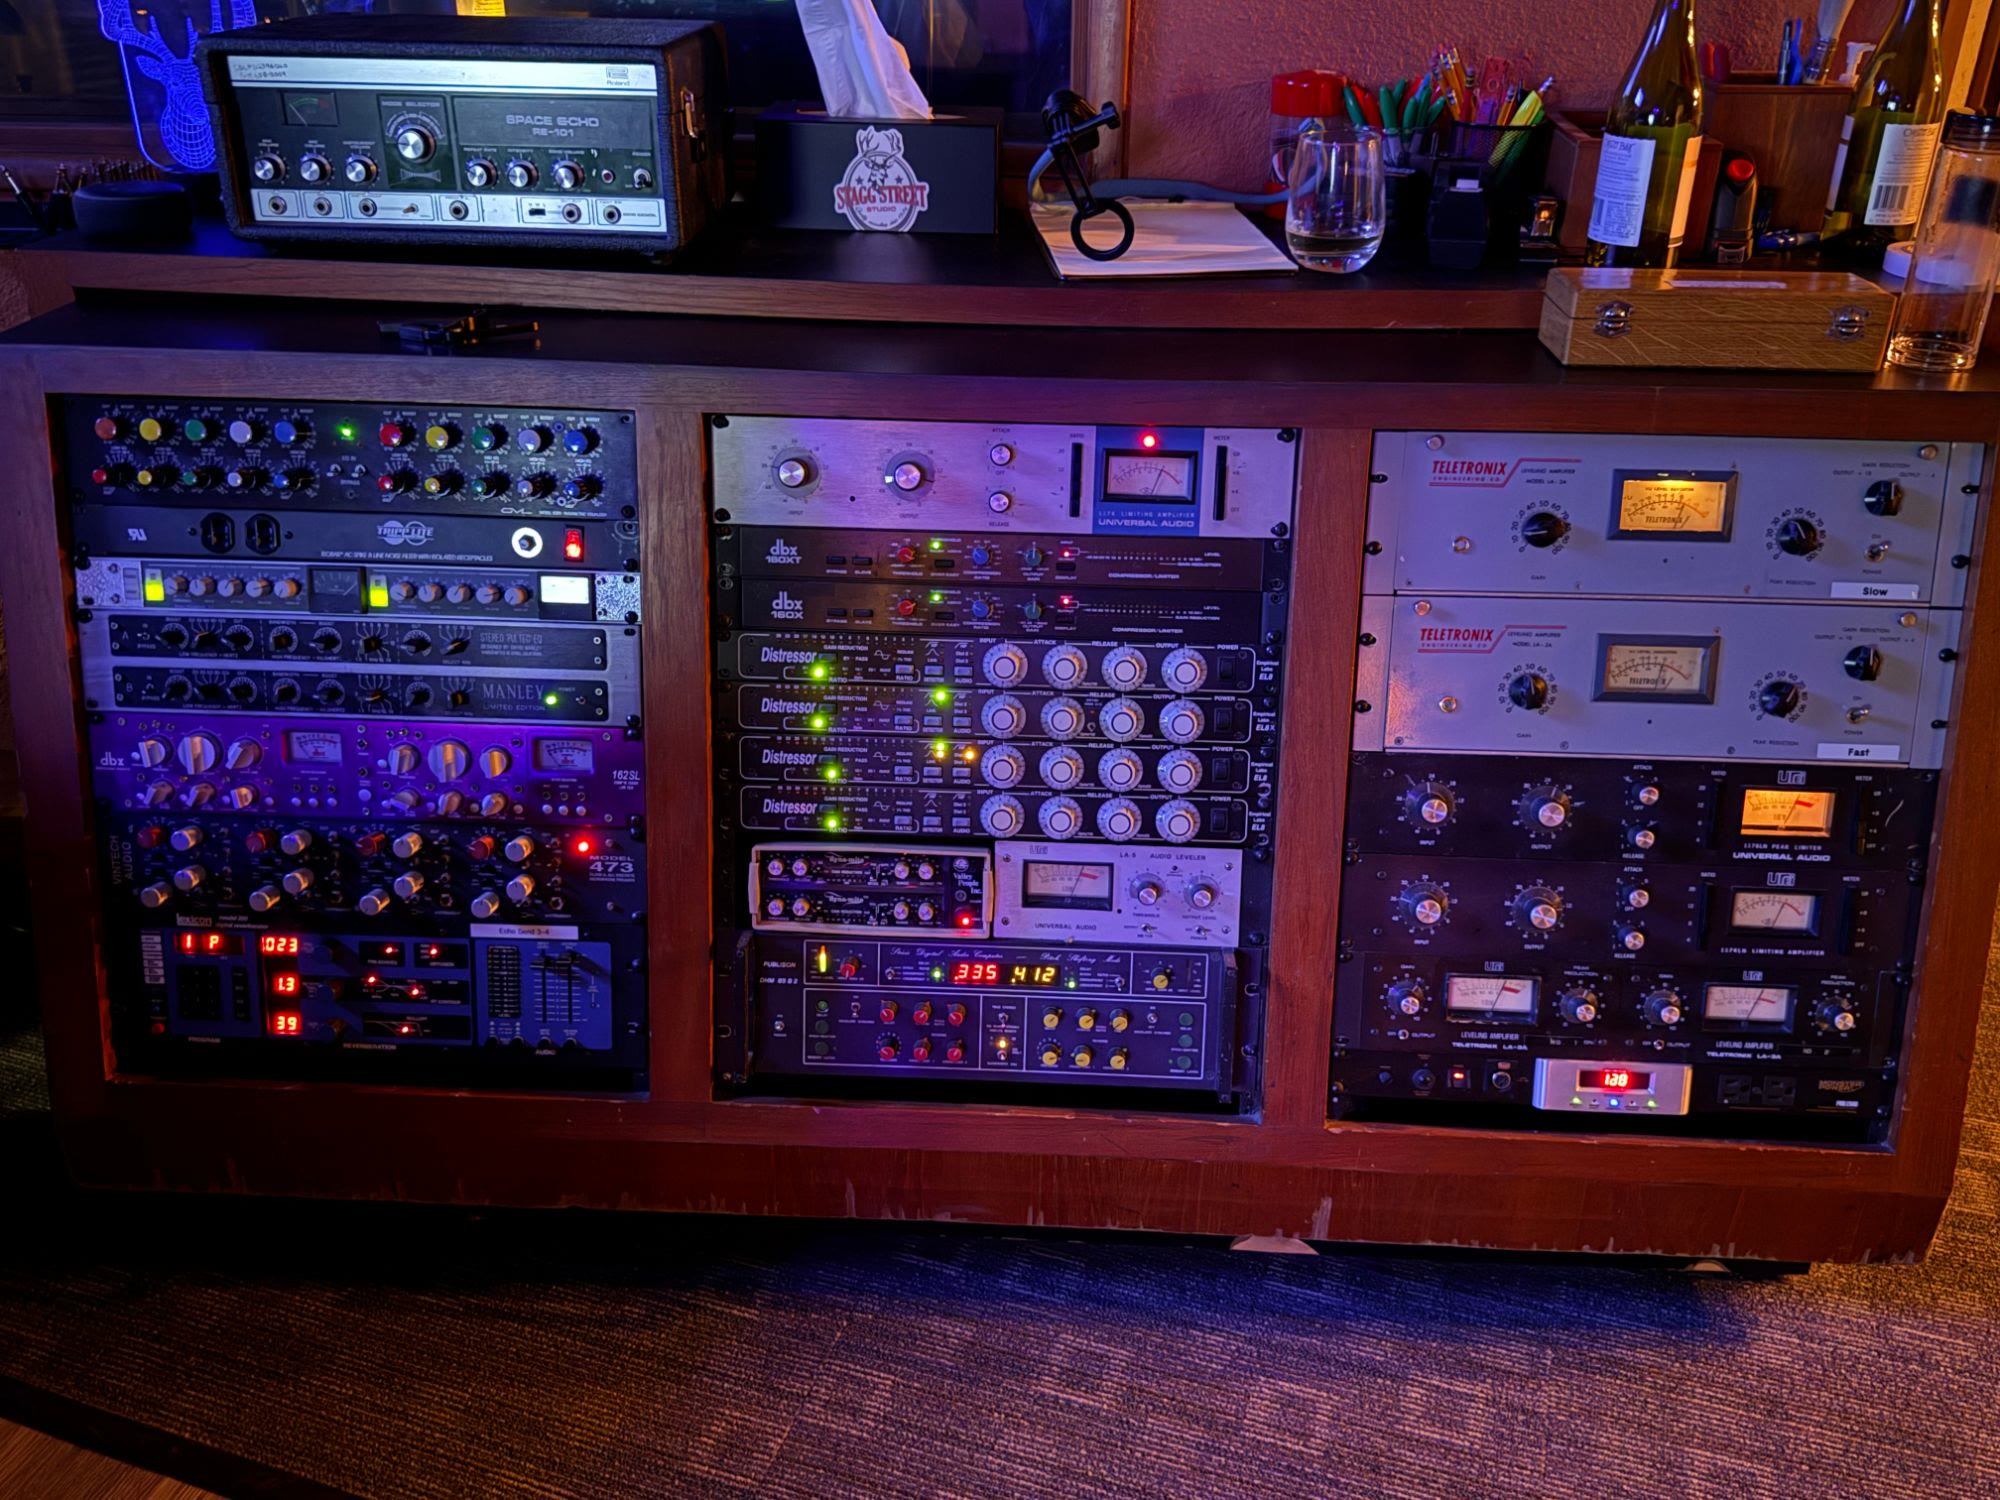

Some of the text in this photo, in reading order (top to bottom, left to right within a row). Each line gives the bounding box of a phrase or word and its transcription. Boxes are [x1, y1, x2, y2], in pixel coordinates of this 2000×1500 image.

[506, 114, 600, 127] SPACE ECHO
[532, 128, 574, 137] RE-101
[836, 185, 927, 210] STAGG STREET
[1431, 460, 1508, 476] TELETRONIX
[1098, 518, 1195, 528] UNIVERSAL AUDIO
[376, 525, 434, 538] TRIPP LITE
[770, 538, 798, 556] dbx
[765, 555, 802, 564] 160XT
[1862, 586, 1888, 597] Slow
[771, 591, 804, 611] dbx
[770, 610, 804, 620] 160X
[480, 632, 505, 643] STEREO
[1420, 627, 1495, 642] TELETRONIX
[761, 646, 817, 664] Distressor
[1258, 672, 1274, 681] EL8
[482, 683, 544, 700] MANLEY
[1152, 693, 1177, 701] OUTPUT
[482, 702, 546, 712] LIMITED EDITION
[761, 697, 816, 714] Distressor
[761, 748, 817, 766] Distressor
[1847, 748, 1870, 757] Fast
[100, 751, 125, 767] dbx
[612, 770, 641, 781] 162SL
[1253, 774, 1268, 782] EL8
[763, 798, 817, 815] Distressor
[1251, 823, 1266, 832] EL8
[110, 835, 122, 886] VINTECH
[121, 841, 134, 881] AUDIO
[1732, 852, 1831, 862] UNIVERSAL AUDIO
[589, 861, 634, 873] 473
[953, 872, 973, 881] Valley
[958, 879, 979, 887] People
[970, 886, 983, 895] Inc.
[176, 912, 213, 927] lexicon
[209, 935, 219, 950] P
[763, 960, 797, 968] PUBLISON
[277, 1015, 298, 1031] 39
[1460, 1031, 1519, 1041] LEVELING AMPLIFIER
[1451, 1041, 1498, 1049] TELETRONIX
[1715, 1040, 1774, 1050] LEVELING AMPLIFIER
[1706, 1051, 1753, 1059] TELETRONIX
